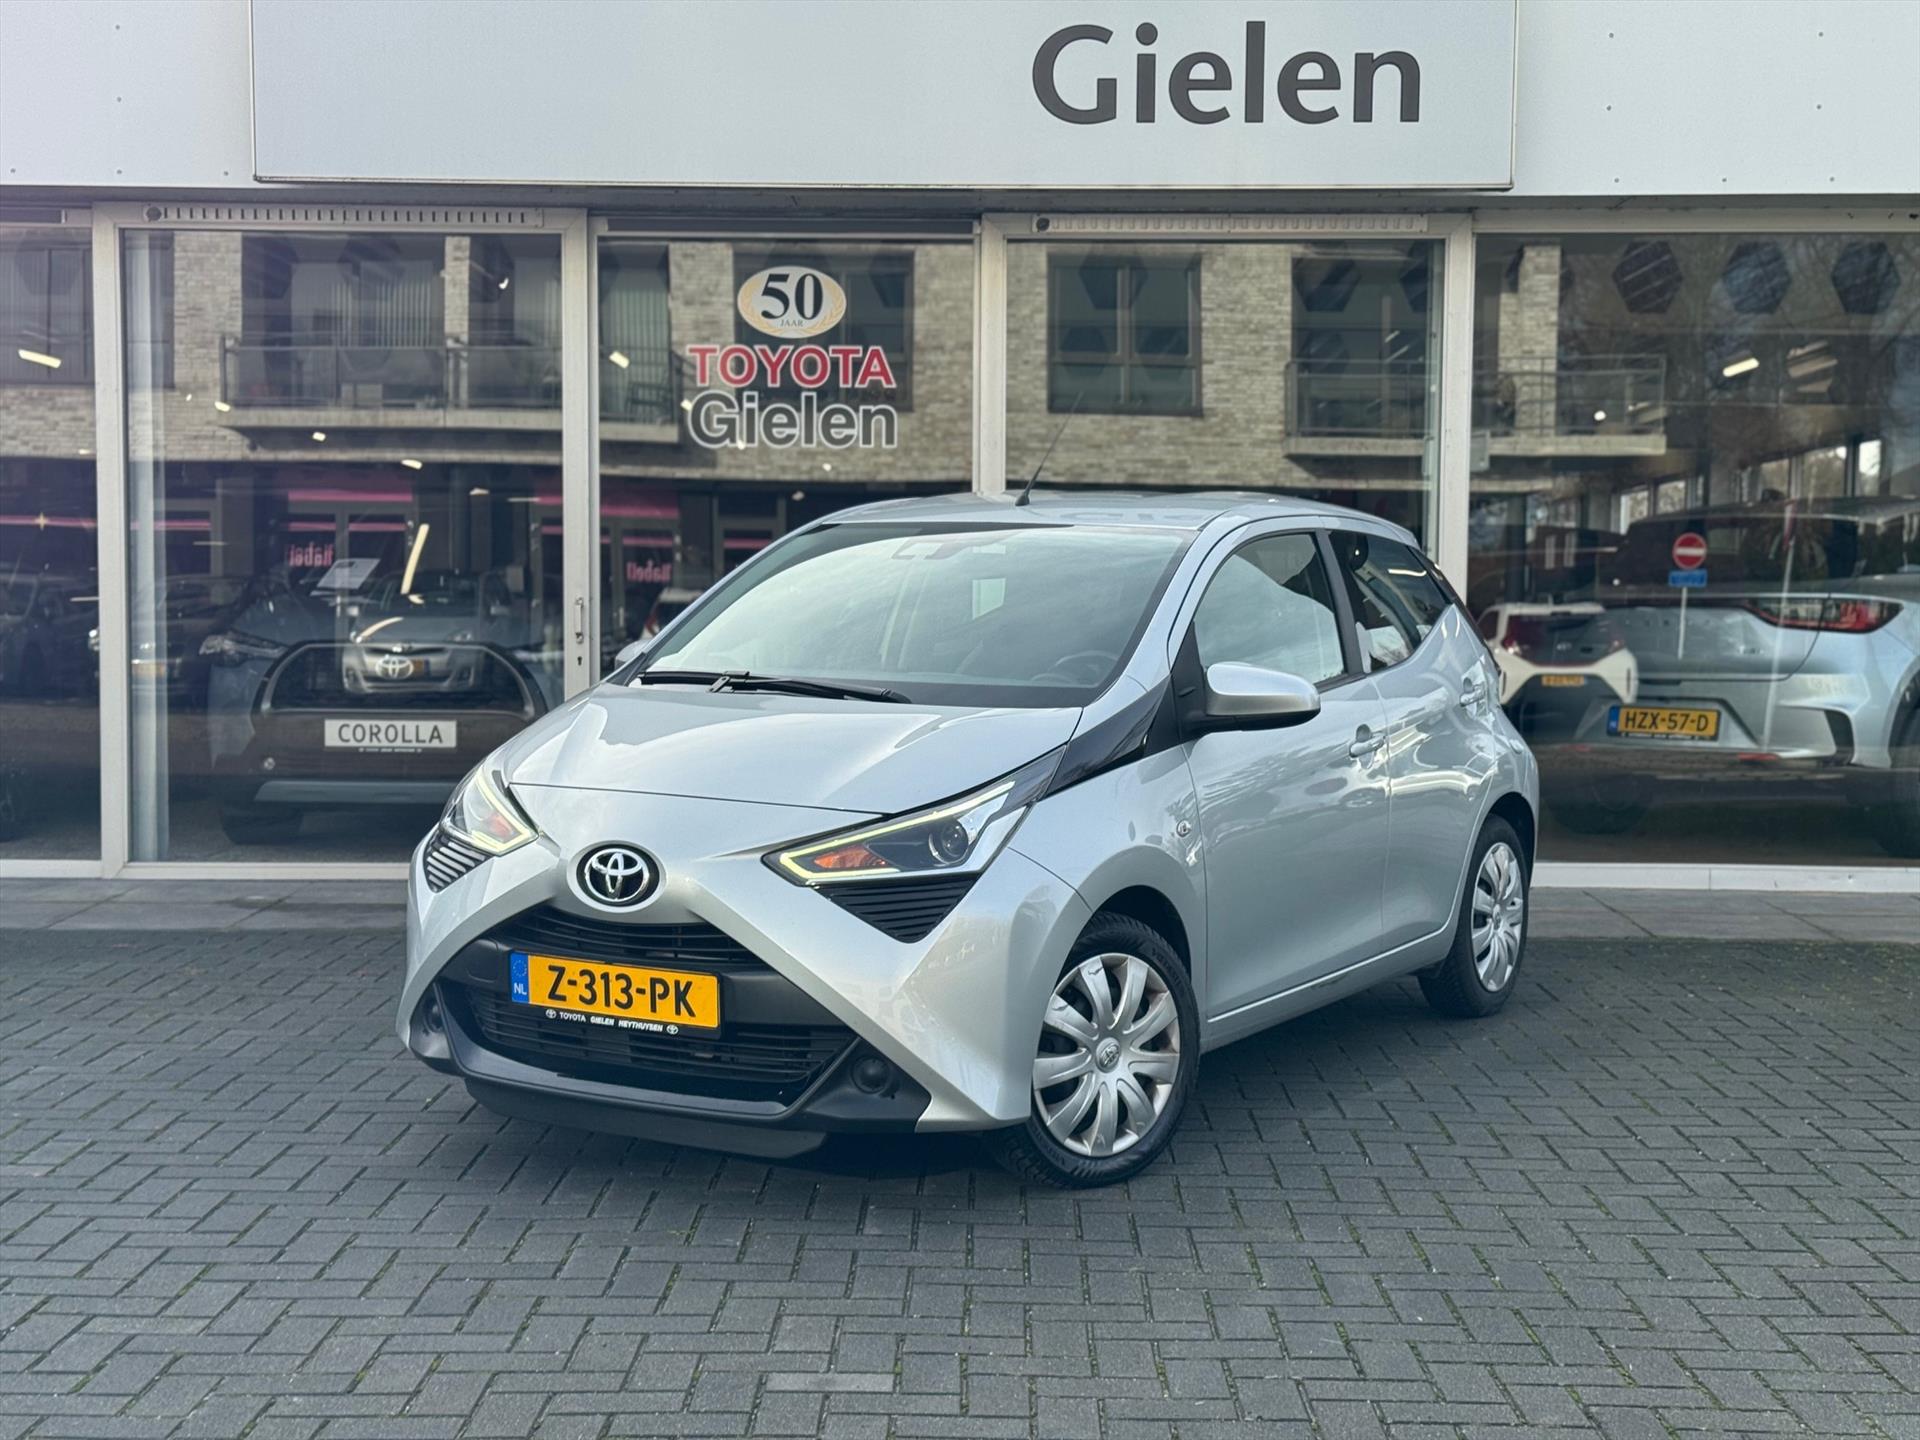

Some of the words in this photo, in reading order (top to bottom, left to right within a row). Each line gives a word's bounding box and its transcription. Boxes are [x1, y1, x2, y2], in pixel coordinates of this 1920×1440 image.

[1032, 21, 1421, 124] Gielen
[761, 273, 823, 320] 50
[780, 319, 804, 327] JAAR
[686, 344, 897, 388] TOYOTA
[688, 389, 898, 448] Gielen
[338, 723, 443, 743] COROLLA
[1624, 711, 1709, 732] HZX-57-D
[513, 983, 527, 996] NL
[547, 964, 696, 1018] Z-313-PK
[559, 1011, 586, 1023] TOYOTA
